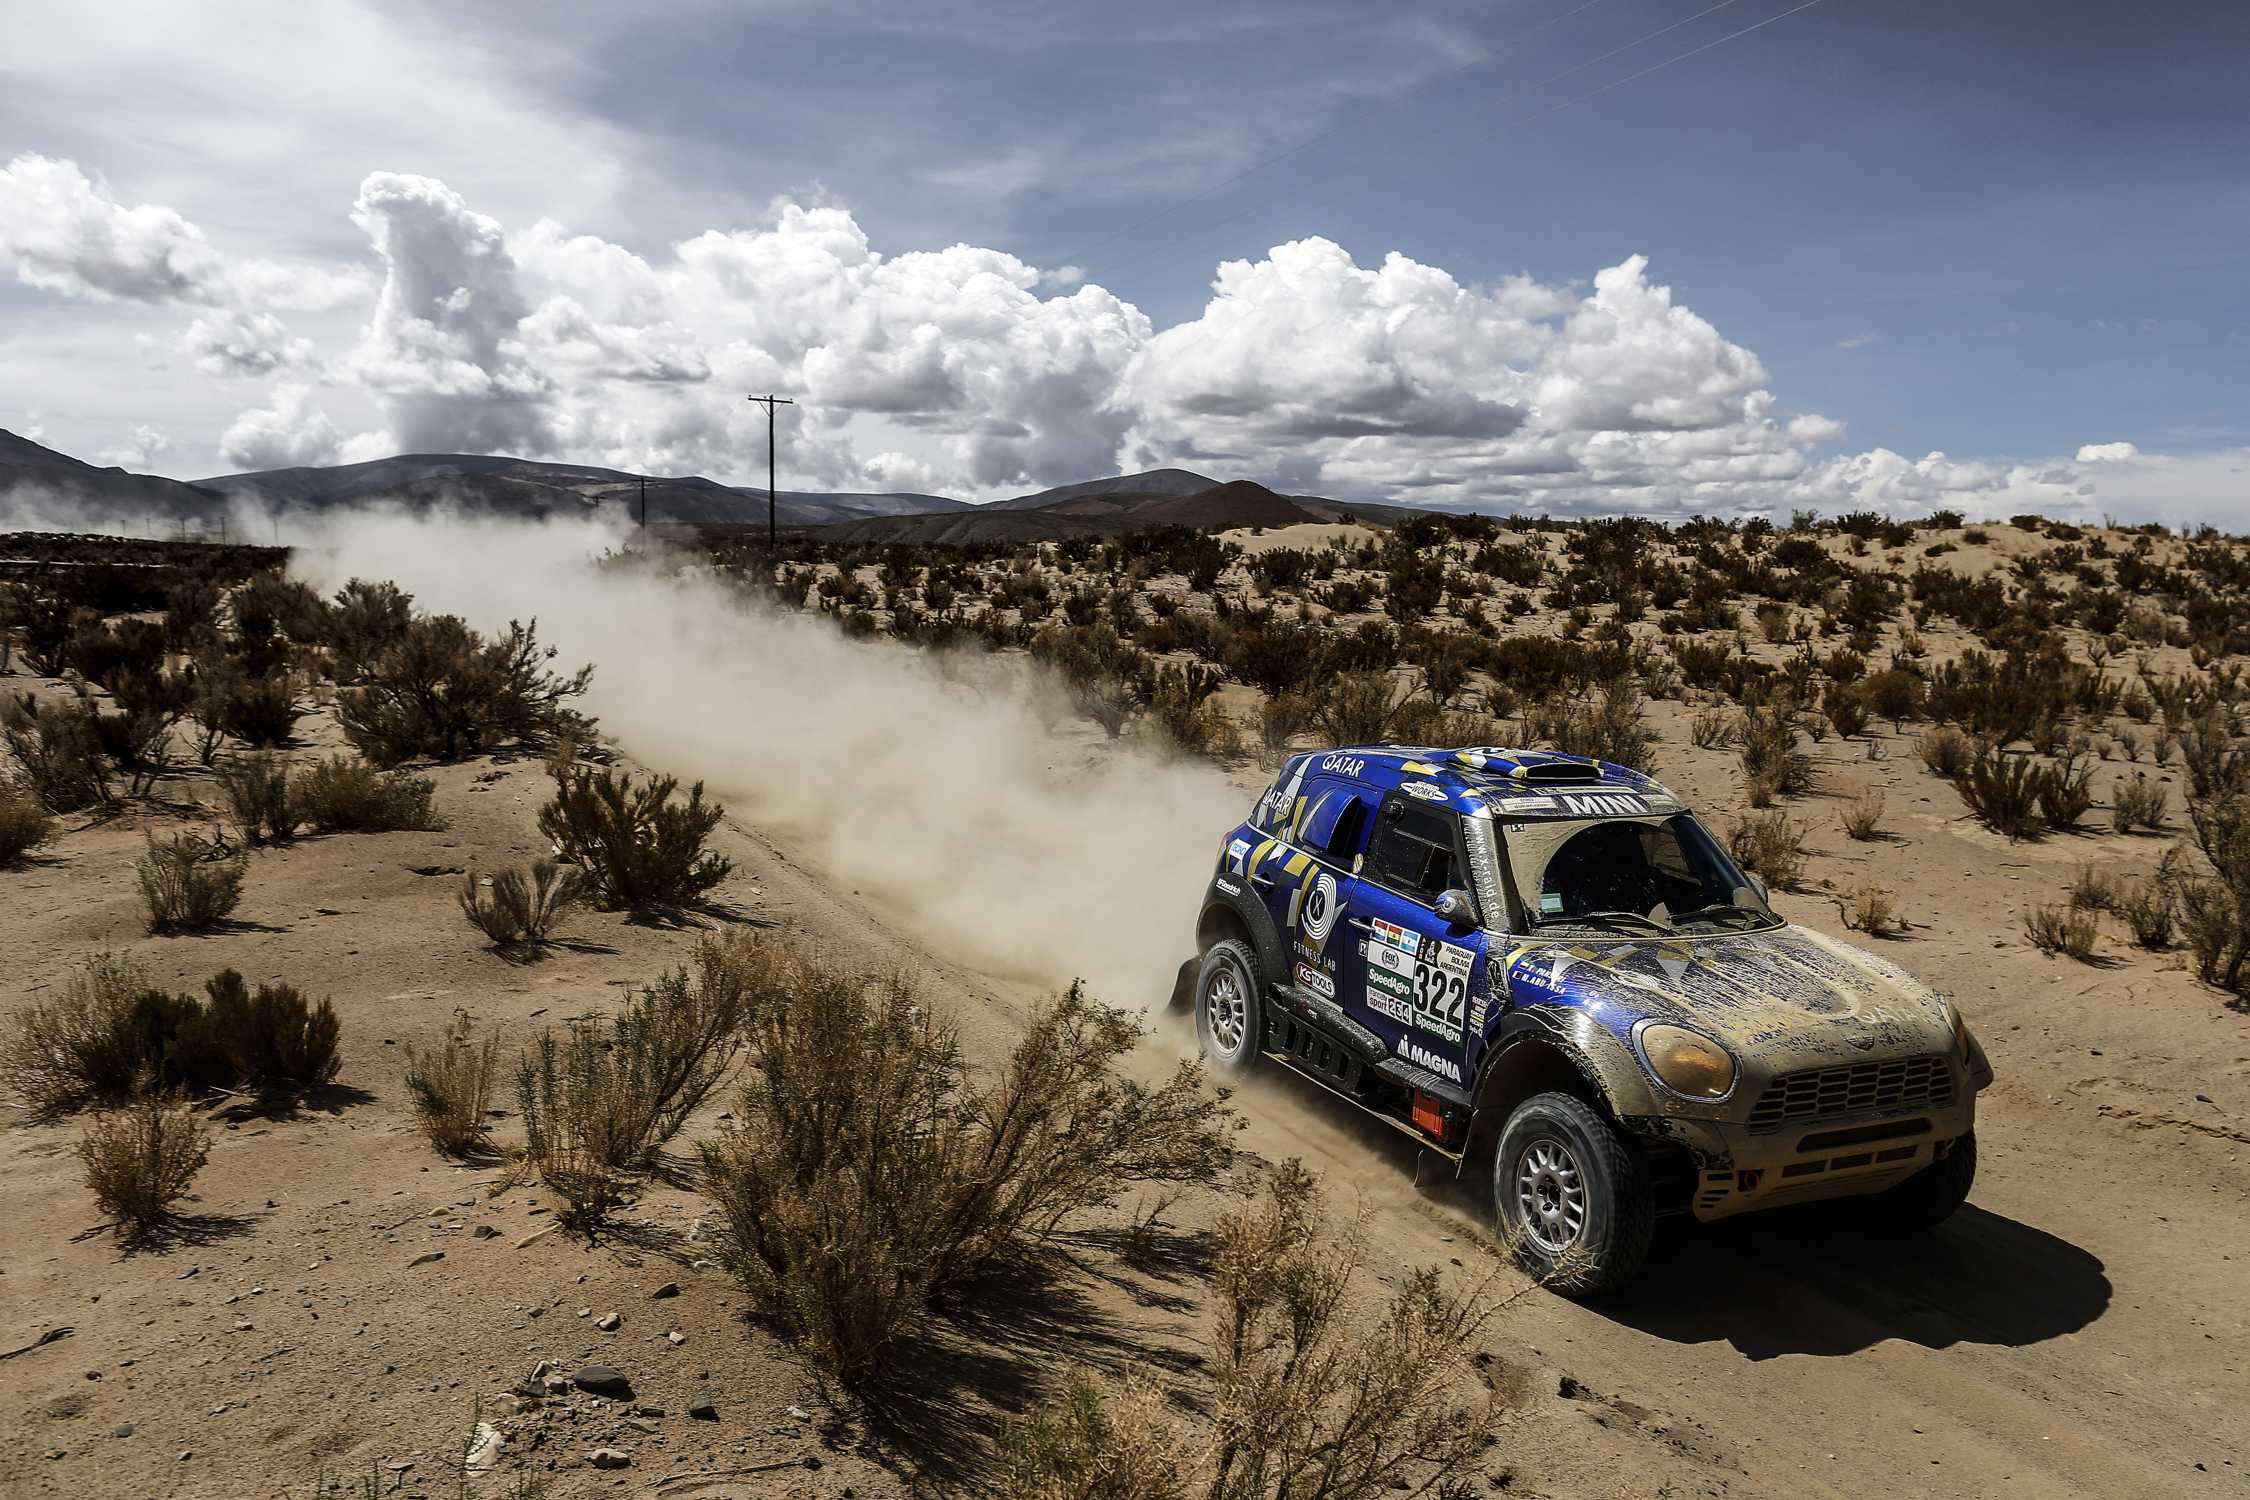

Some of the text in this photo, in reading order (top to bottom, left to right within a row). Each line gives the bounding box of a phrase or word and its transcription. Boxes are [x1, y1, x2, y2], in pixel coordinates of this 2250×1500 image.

[1322, 755, 1365, 778] QATAR
[1262, 787, 1293, 817] QATAR
[1411, 784, 1436, 799] WORKS
[1561, 795, 1649, 814] MINI
[1293, 940, 1336, 972] FITNESS LAB
[1384, 951, 1396, 963] FOX
[1446, 946, 1473, 961] PARAGUAY
[1451, 956, 1470, 969] BOLIVIA
[1439, 961, 1468, 977] ARGENTINA
[1368, 968, 1410, 995] SpeedAgro
[1369, 997, 1387, 1011] sport
[1413, 963, 1465, 1028] 322
[1415, 1013, 1461, 1043] SpeedAgro
[1410, 1044, 1462, 1083] MAGNA
